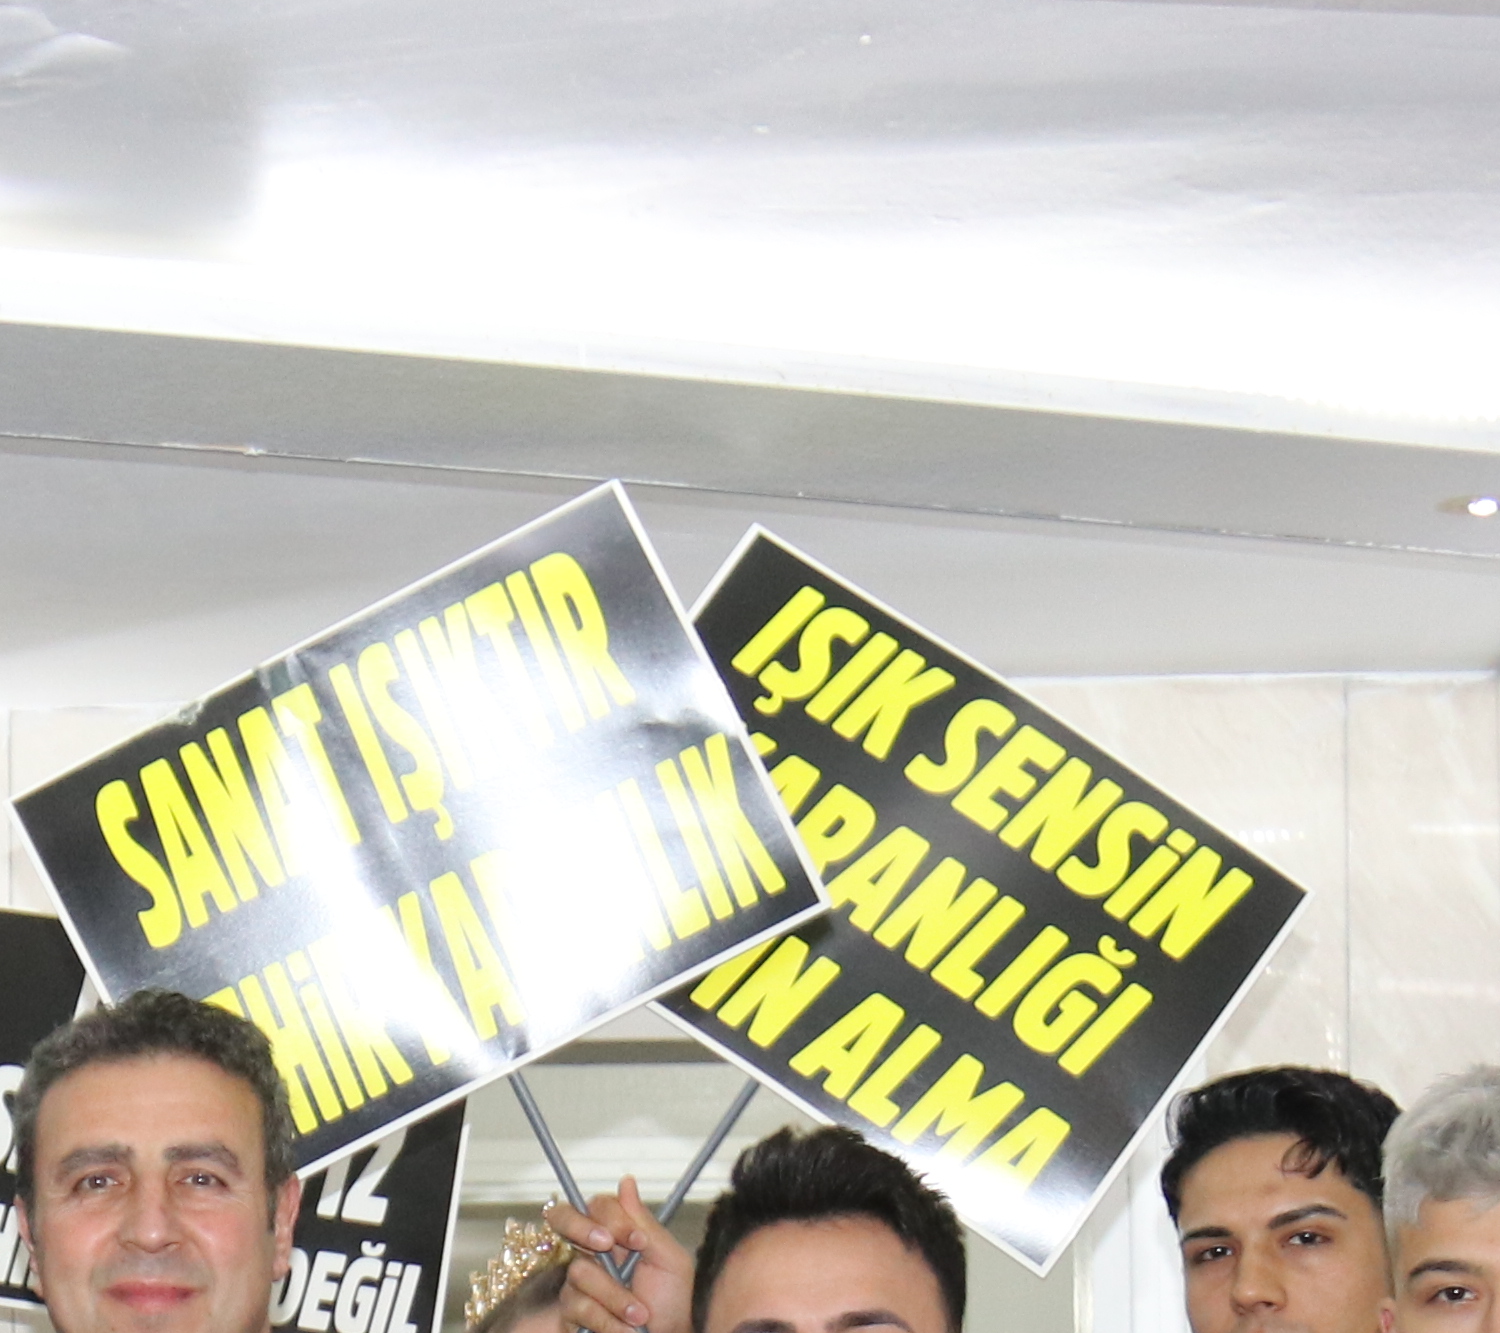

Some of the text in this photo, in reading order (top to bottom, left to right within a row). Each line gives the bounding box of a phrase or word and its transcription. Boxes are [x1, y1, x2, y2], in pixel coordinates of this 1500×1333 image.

[97, 552, 636, 948] SANAT IŞIKTIR
[731, 584, 1254, 960] IŞIK SENSİN
[748, 730, 1154, 1078] ARANLIĞI
[787, 991, 1072, 1194] ALMA
